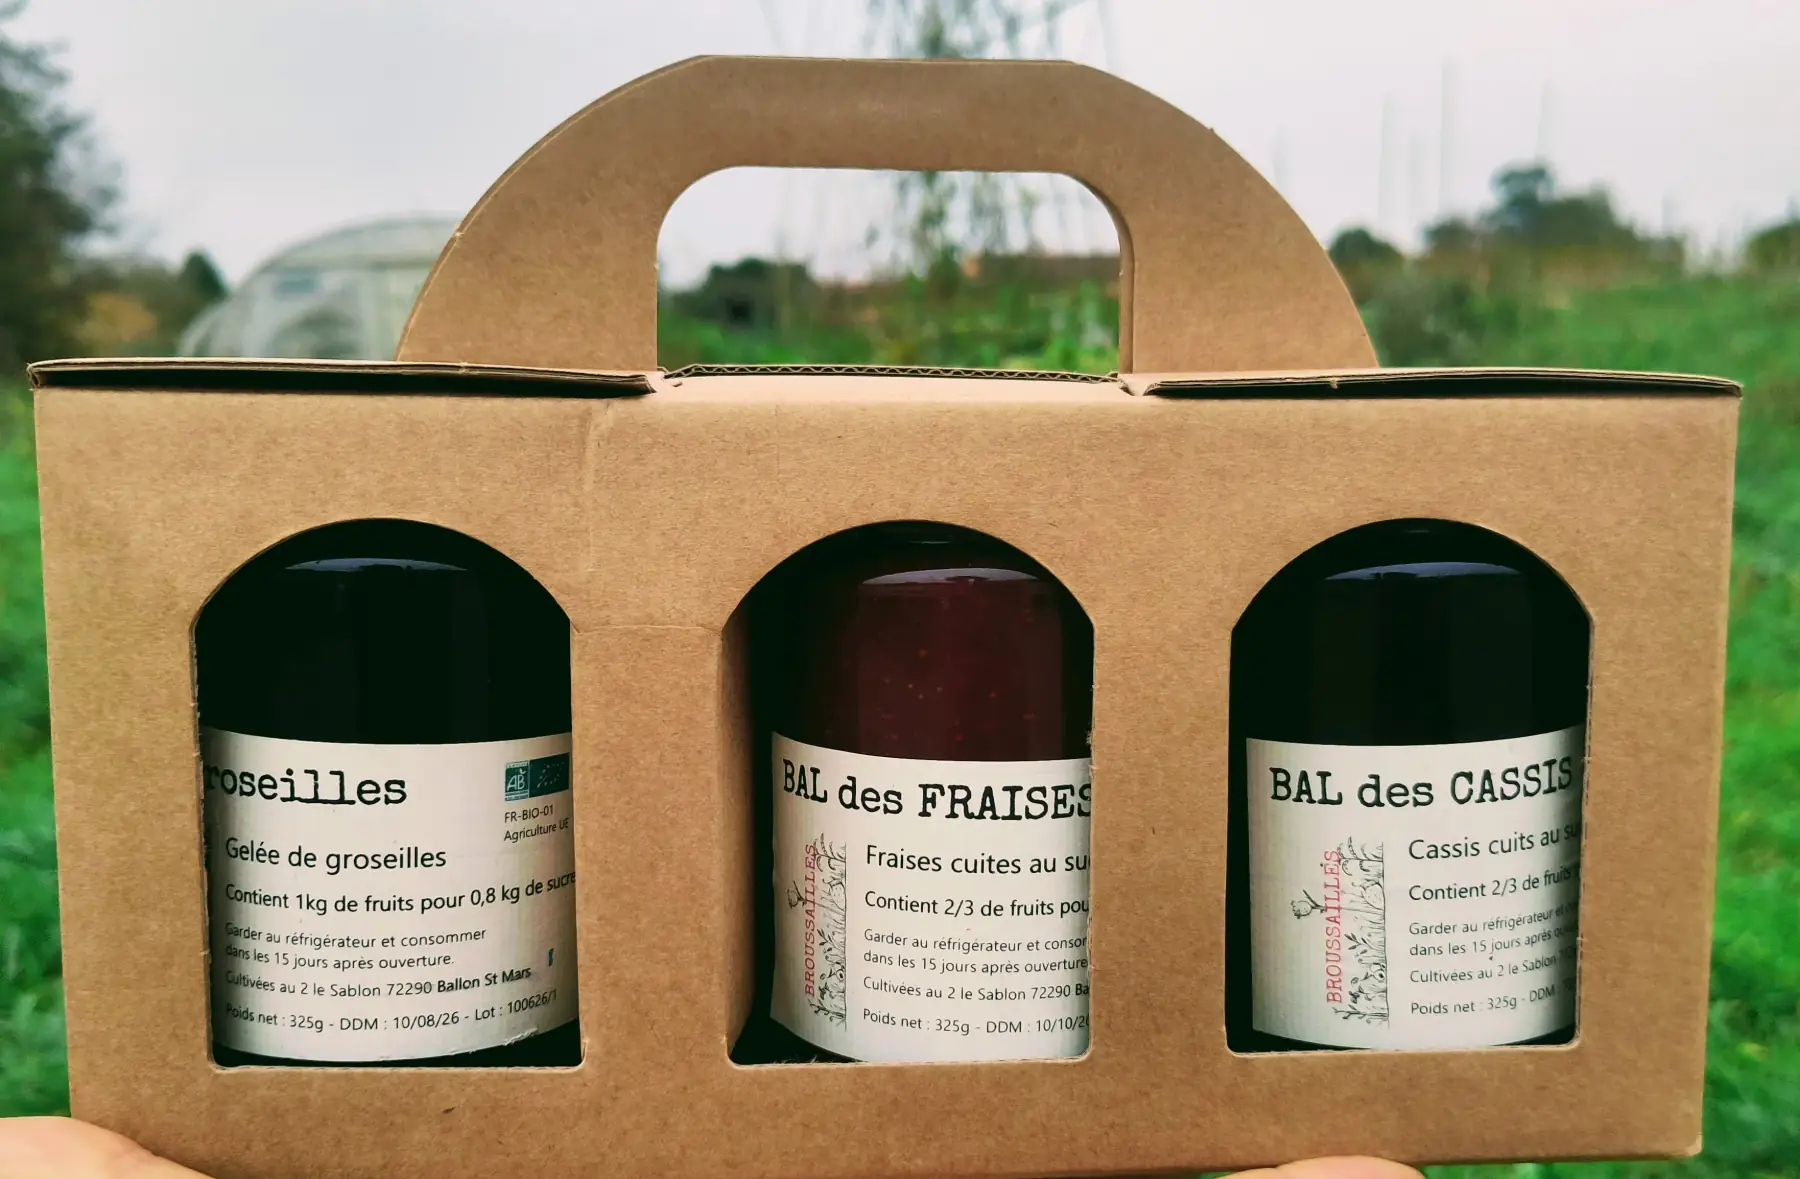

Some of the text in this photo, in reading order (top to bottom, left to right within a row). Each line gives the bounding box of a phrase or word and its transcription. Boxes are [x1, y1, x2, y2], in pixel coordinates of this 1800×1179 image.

[507, 774, 525, 791] AB
[783, 758, 827, 803] BAL
[838, 775, 903, 815] des
[1269, 755, 1573, 807] BAL des CASSIS
[504, 804, 554, 822] FR-BIO-01
[504, 817, 571, 843] Agriculture UE
[1408, 836, 1480, 860] Cassis
[1488, 831, 1535, 854] cuits
[1540, 828, 1560, 846] au
[225, 837, 447, 875] Gelée de groseilles
[867, 844, 1090, 874] Fraises cuites au su
[225, 871, 576, 915] Contient 1kg de fruits pour 0,8 kg de sucre
[1408, 883, 1486, 901] Contient
[1492, 877, 1517, 896] 2/3
[1522, 874, 1540, 891] de
[1543, 866, 1571, 886] fruits
[865, 890, 938, 914] Contient
[944, 898, 974, 918] 2/3
[980, 900, 1004, 917] de
[1010, 899, 1054, 916] fruits
[804, 843, 816, 997] BROUSSAILLES
[1324, 850, 1343, 1004] BROUSSAILLES
[1409, 922, 1457, 935] Garder
[1462, 923, 1478, 933] au
[1482, 908, 1555, 931] réfrigérateur
[225, 922, 486, 950] Garder au réfrigérateur et consommer
[864, 928, 908, 946] Garder
[912, 938, 928, 948] au
[933, 936, 1022, 955] réfrigérateur
[1026, 940, 1040, 951] et
[1409, 943, 1443, 956] dans
[1448, 942, 1466, 954] les
[1472, 939, 1487, 953] 15
[1488, 938, 1521, 954] jours
[1524, 930, 1552, 947] après
[226, 944, 454, 972] dans les 15 jours après ouverture.
[863, 949, 893, 966] dans
[898, 954, 916, 969] les
[921, 957, 937, 970] 15
[940, 958, 977, 975] jours
[981, 960, 1020, 976] après
[1410, 955, 1556, 983] Cultivées au 2 le Sablon
[226, 967, 532, 997] Cultivées au 2 le Sablon 72290 Ballon St Mars
[863, 976, 921, 996] Cultivées
[925, 987, 942, 999] au
[947, 986, 956, 999] 2
[960, 987, 973, 1000] le
[978, 987, 1026, 1001] Sablon
[1031, 984, 1071, 999] 72290
[1411, 1001, 1448, 1015] Poids
[1453, 1001, 1475, 1013] net
[1487, 996, 1517, 1010] 325g
[1529, 984, 1555, 1002] DDM
[226, 1003, 255, 1022] Poids
[258, 1013, 278, 1026] net
[289, 1014, 324, 1033] 325g
[340, 1017, 379, 1031] DDM
[393, 1011, 460, 1030] 10/08/26
[475, 1006, 496, 1021] Lot
[863, 1008, 896, 1026] Poids
[901, 1017, 922, 1030] net
[935, 1018, 970, 1036] 325g
[986, 1020, 1022, 1033] DDM
